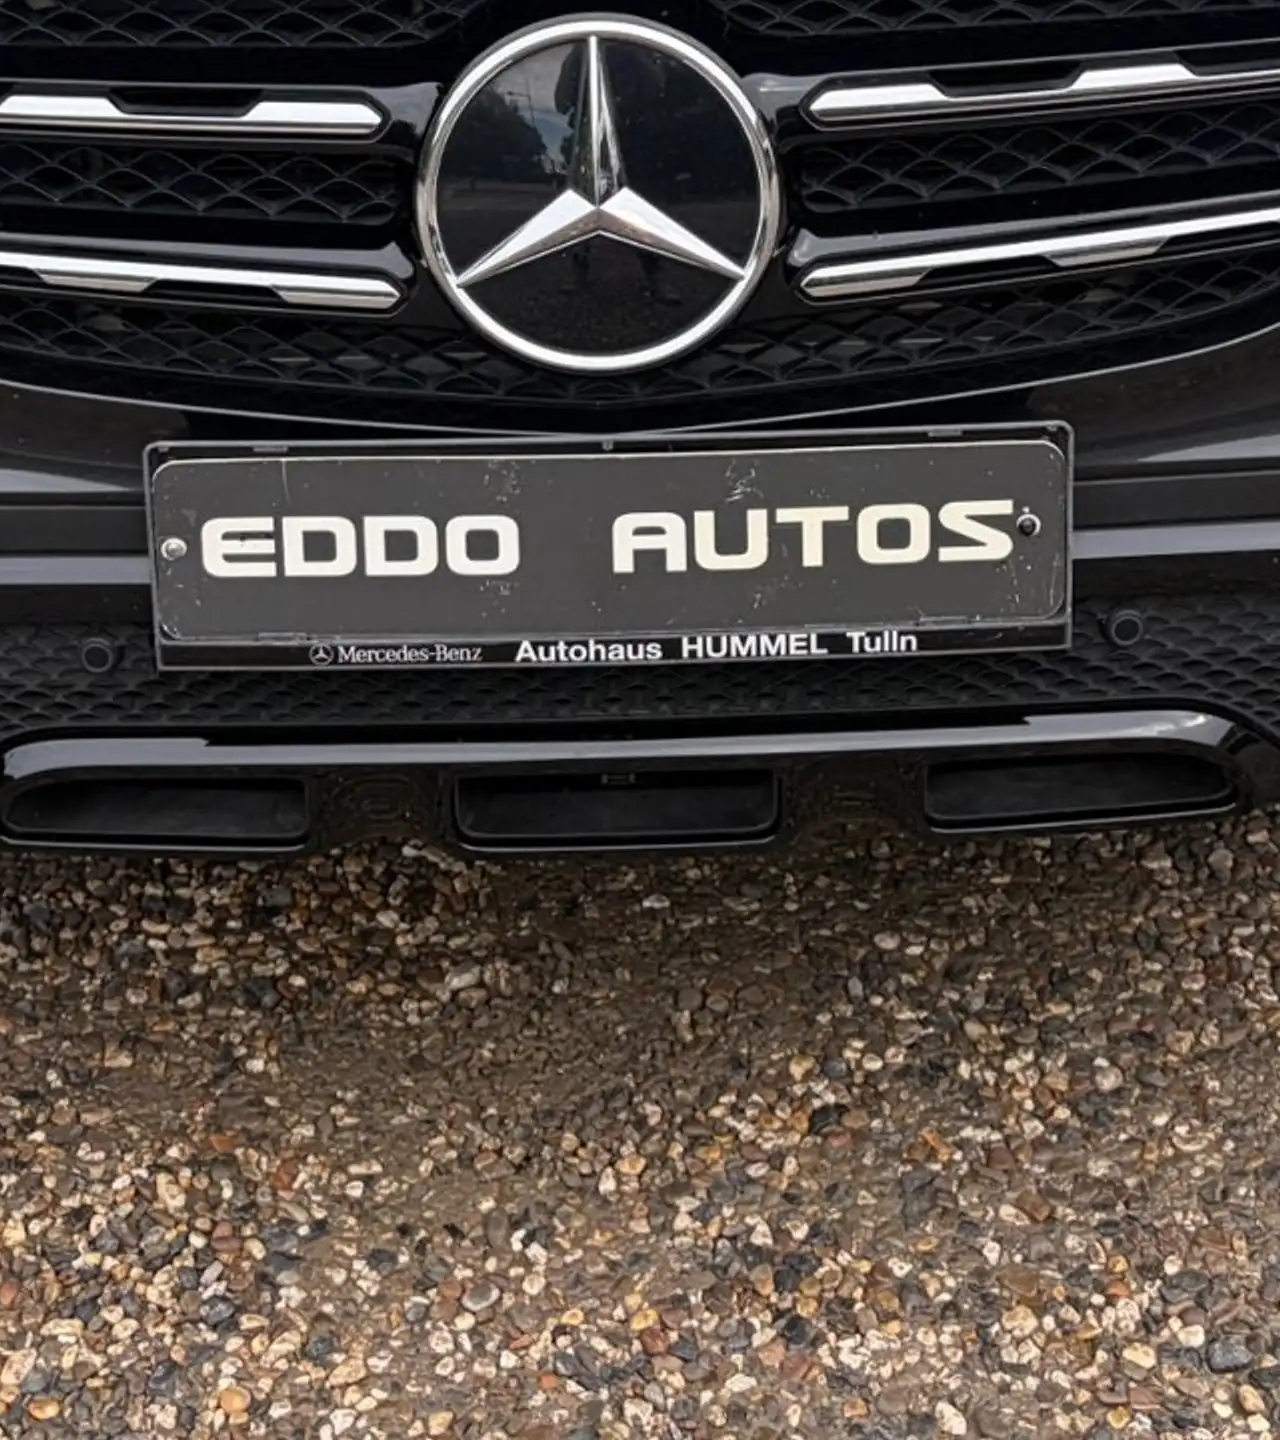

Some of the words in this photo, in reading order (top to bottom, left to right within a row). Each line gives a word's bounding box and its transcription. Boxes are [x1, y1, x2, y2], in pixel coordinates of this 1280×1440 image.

[201, 515, 521, 578] EDDO
[611, 499, 1014, 574] AUTOS
[337, 643, 483, 664] Mercedes-Benz
[515, 638, 662, 663] Autohaus
[681, 633, 828, 659] HUMMEL
[846, 630, 918, 654] Tulln
